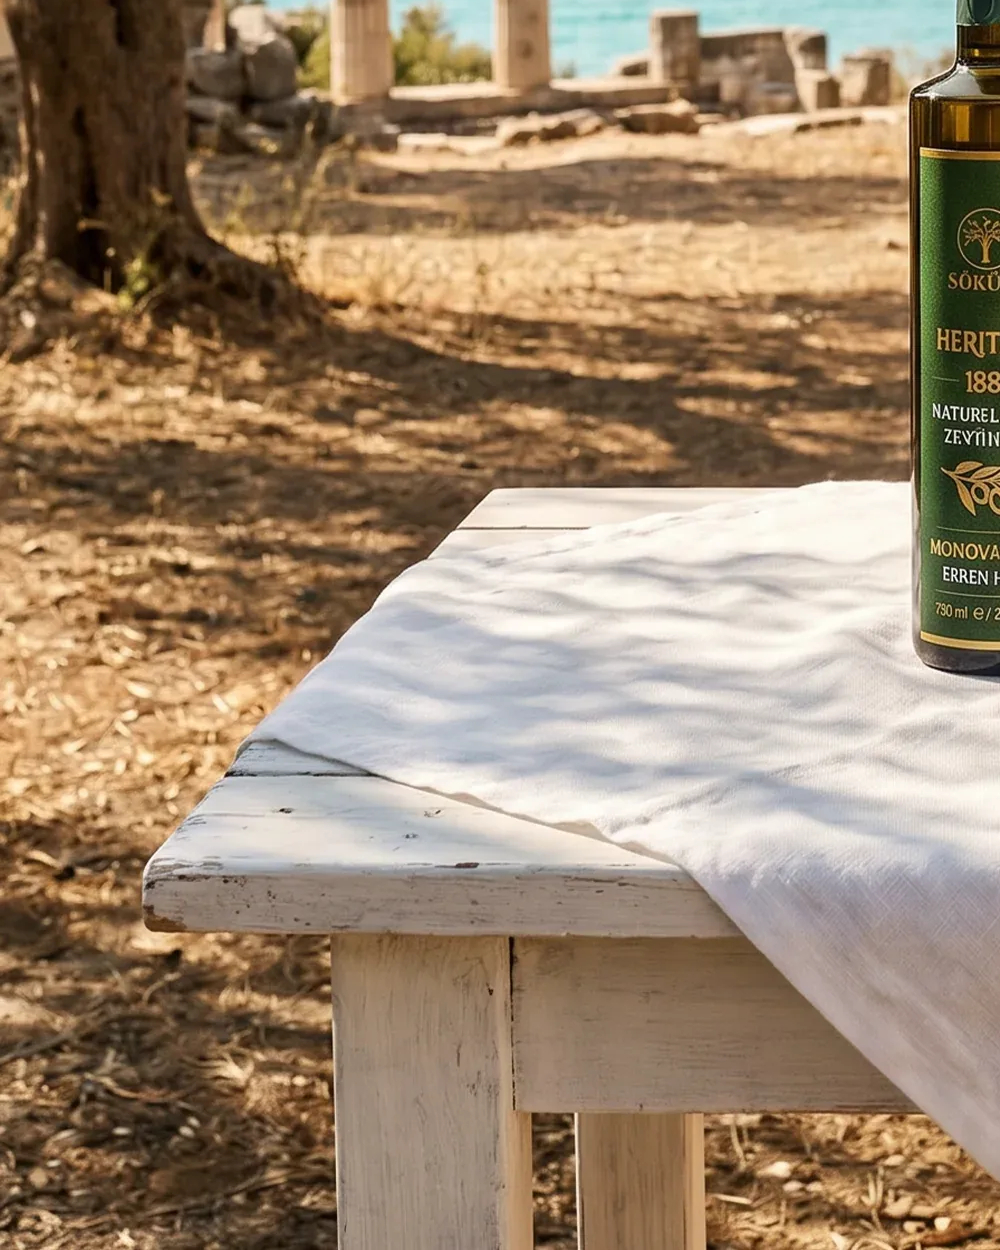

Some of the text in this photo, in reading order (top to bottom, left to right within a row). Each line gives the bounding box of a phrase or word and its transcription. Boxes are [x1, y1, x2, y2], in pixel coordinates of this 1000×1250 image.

[932, 402, 999, 423] NATUREL
[942, 566, 989, 585] ERREN
[955, 606, 968, 619] ml
